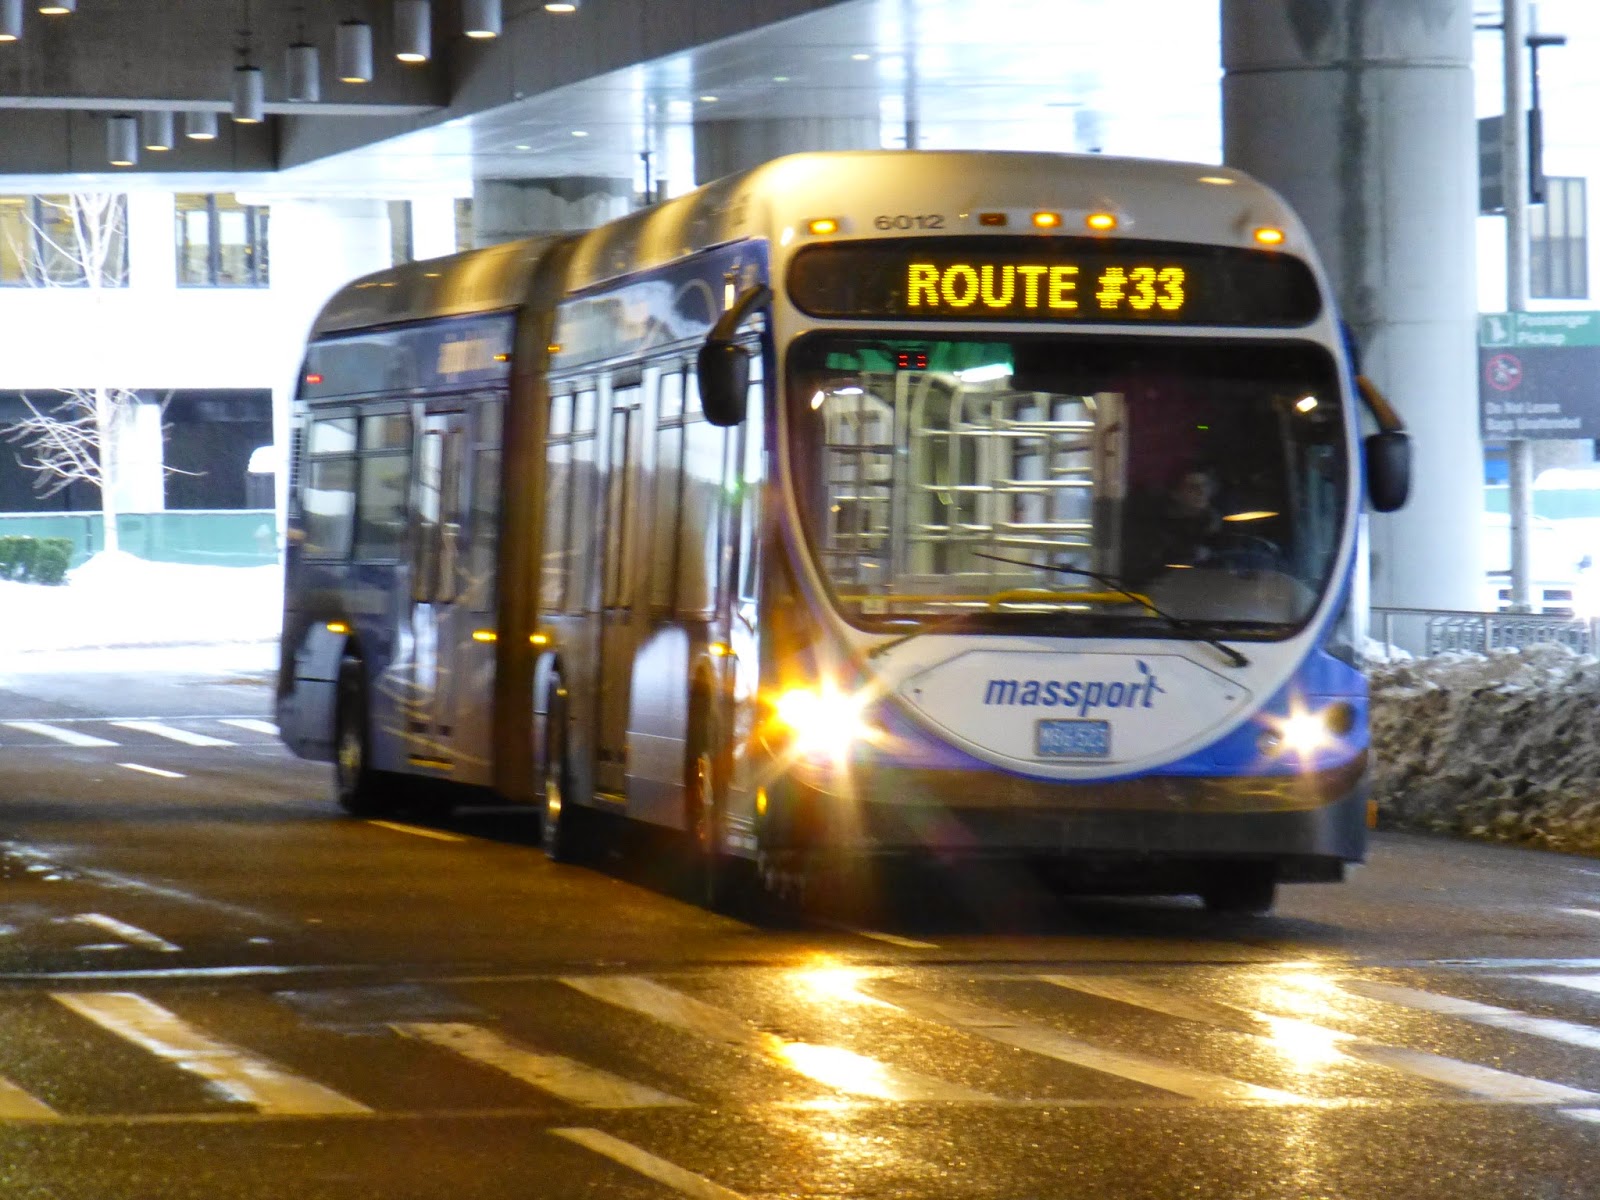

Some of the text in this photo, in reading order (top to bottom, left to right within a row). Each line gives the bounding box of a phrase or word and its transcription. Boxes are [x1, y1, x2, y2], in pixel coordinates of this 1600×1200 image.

[874, 214, 945, 231] 6012
[908, 264, 1185, 310] ROUTE #33
[984, 658, 1166, 717] massport
